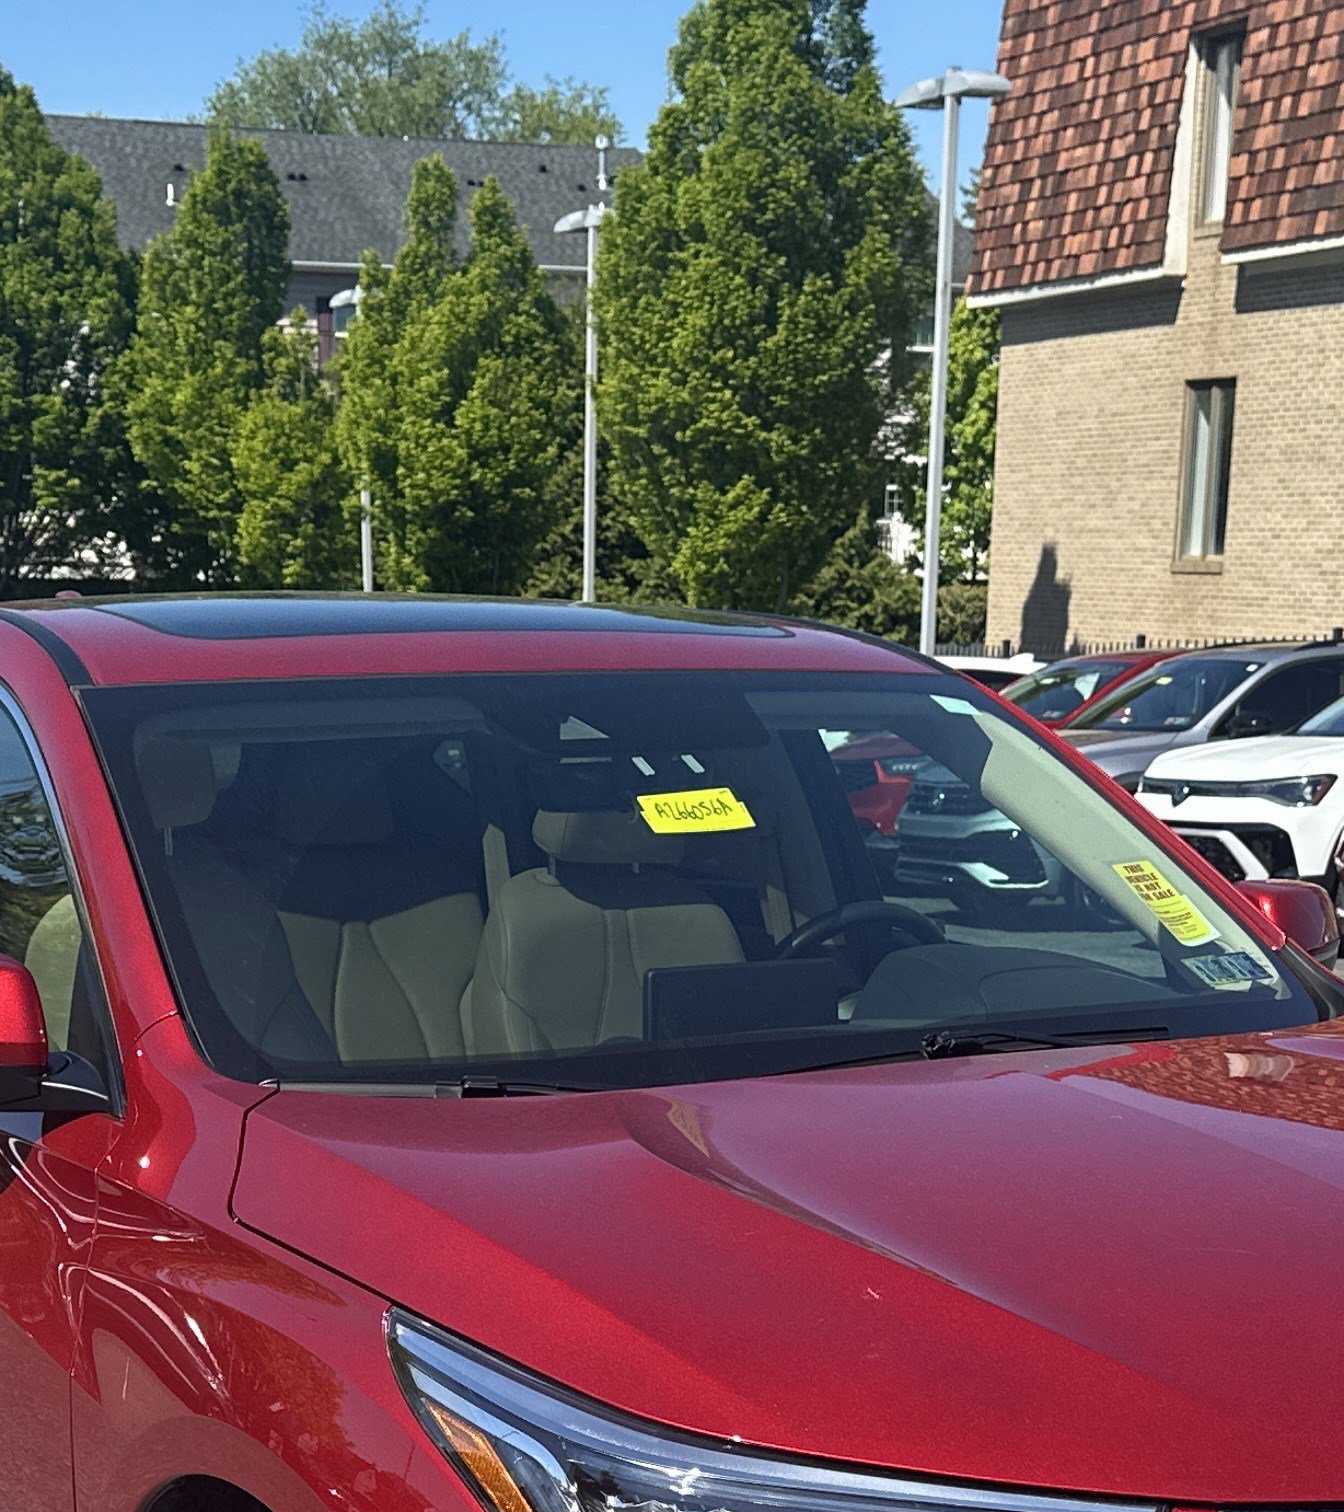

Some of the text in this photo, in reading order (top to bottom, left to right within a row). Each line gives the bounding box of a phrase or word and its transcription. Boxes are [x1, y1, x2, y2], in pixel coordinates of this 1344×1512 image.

[1123, 864, 1145, 875] THIS
[1125, 872, 1159, 884] VEHICLE
[1134, 881, 1162, 893] IS NOT
[1152, 889, 1176, 901] SALE
